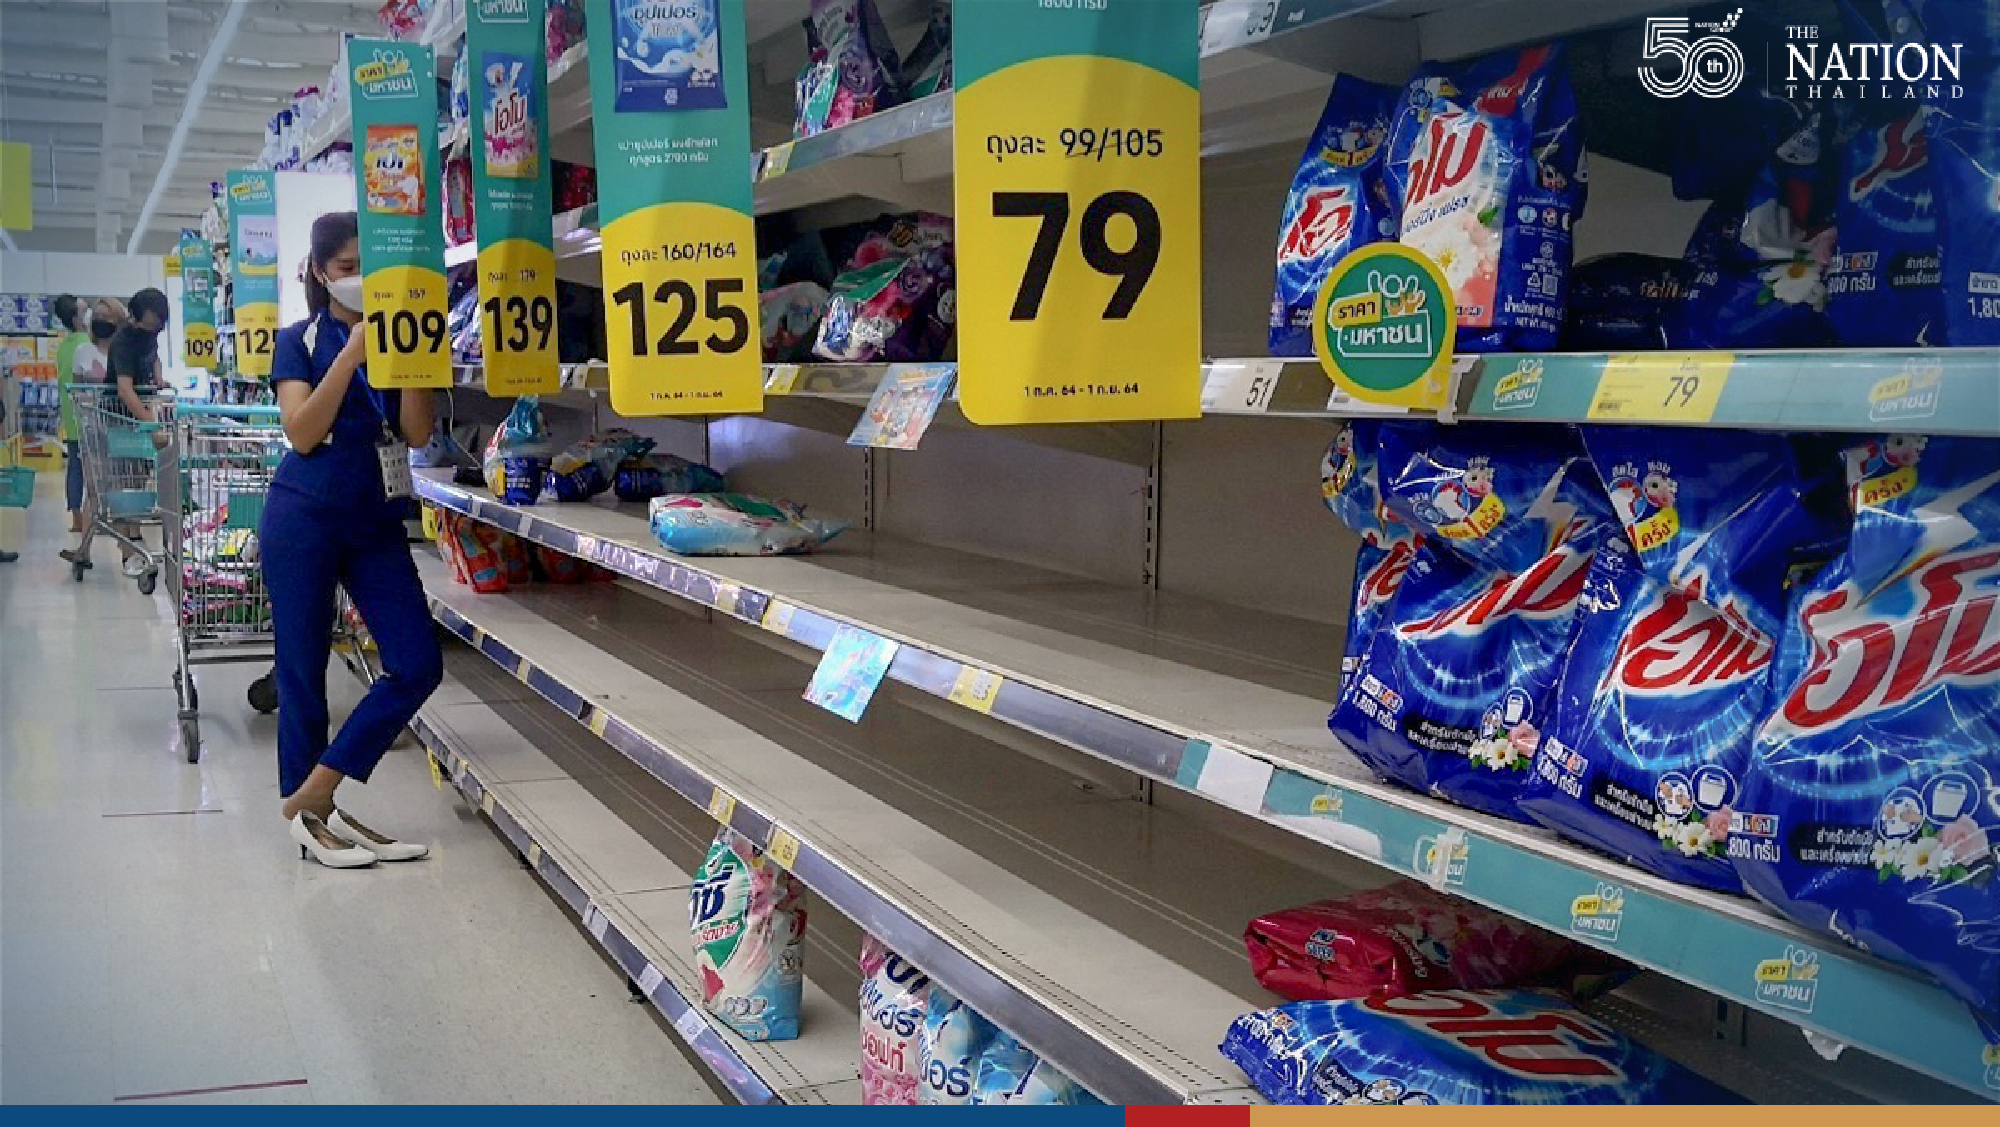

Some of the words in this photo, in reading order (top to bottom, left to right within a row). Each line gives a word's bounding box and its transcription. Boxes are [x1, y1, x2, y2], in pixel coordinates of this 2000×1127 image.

[987, 134, 1046, 163] ถุงละ
[1060, 127, 1164, 163] 99/105
[621, 250, 658, 267] ถุงละ
[662, 241, 737, 263] 160/164
[991, 190, 1163, 321] 79
[484, 295, 553, 353] 139
[612, 278, 749, 357] 125
[1337, 301, 1376, 319] ราคา
[239, 327, 276, 354] 12
[368, 308, 446, 354] 109
[1350, 323, 1423, 345] มหาชน
[185, 339, 214, 357] 109
[1024, 384, 1030, 397] 1
[1061, 384, 1076, 396] 64
[1087, 384, 1094, 396] 1
[1124, 382, 1139, 394] 64
[1247, 377, 1272, 407] 51
[1662, 376, 1699, 408] 79
[1753, 839, 1781, 863] กรัม
